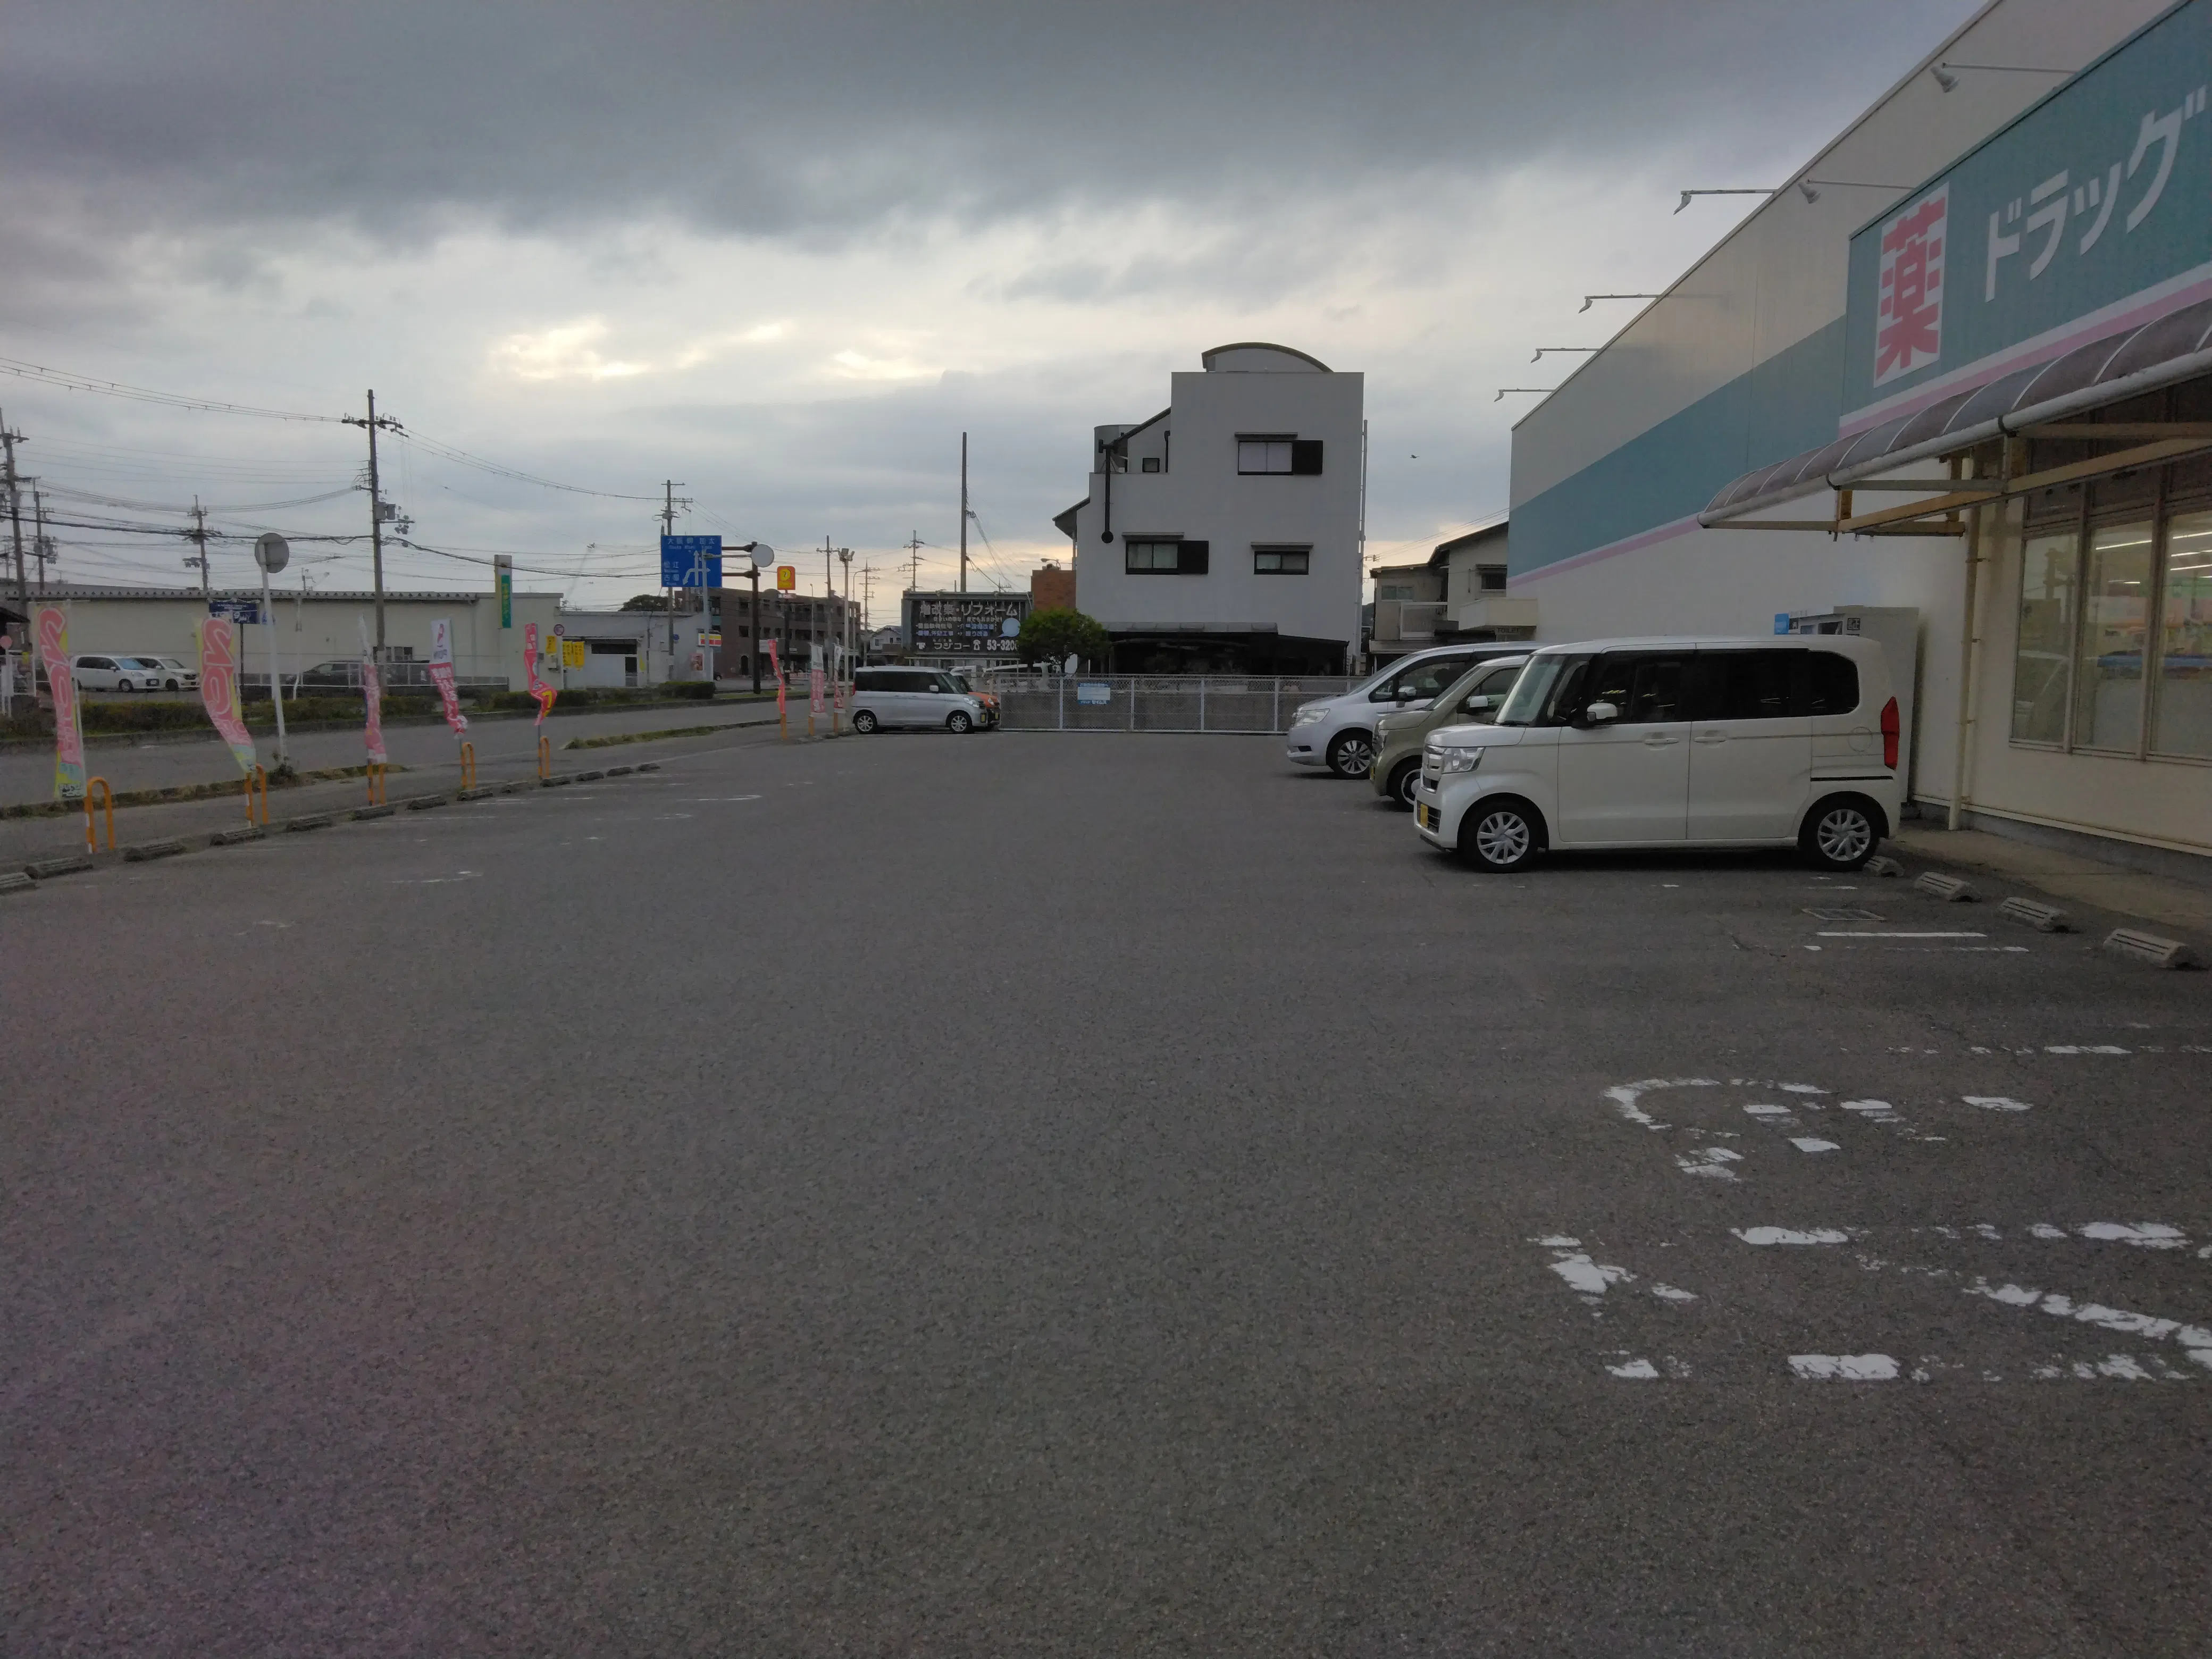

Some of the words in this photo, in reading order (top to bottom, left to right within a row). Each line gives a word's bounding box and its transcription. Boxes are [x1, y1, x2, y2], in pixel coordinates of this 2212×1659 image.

[1876, 197, 1946, 380] 薬
[1985, 85, 2207, 303] ドラッグ
